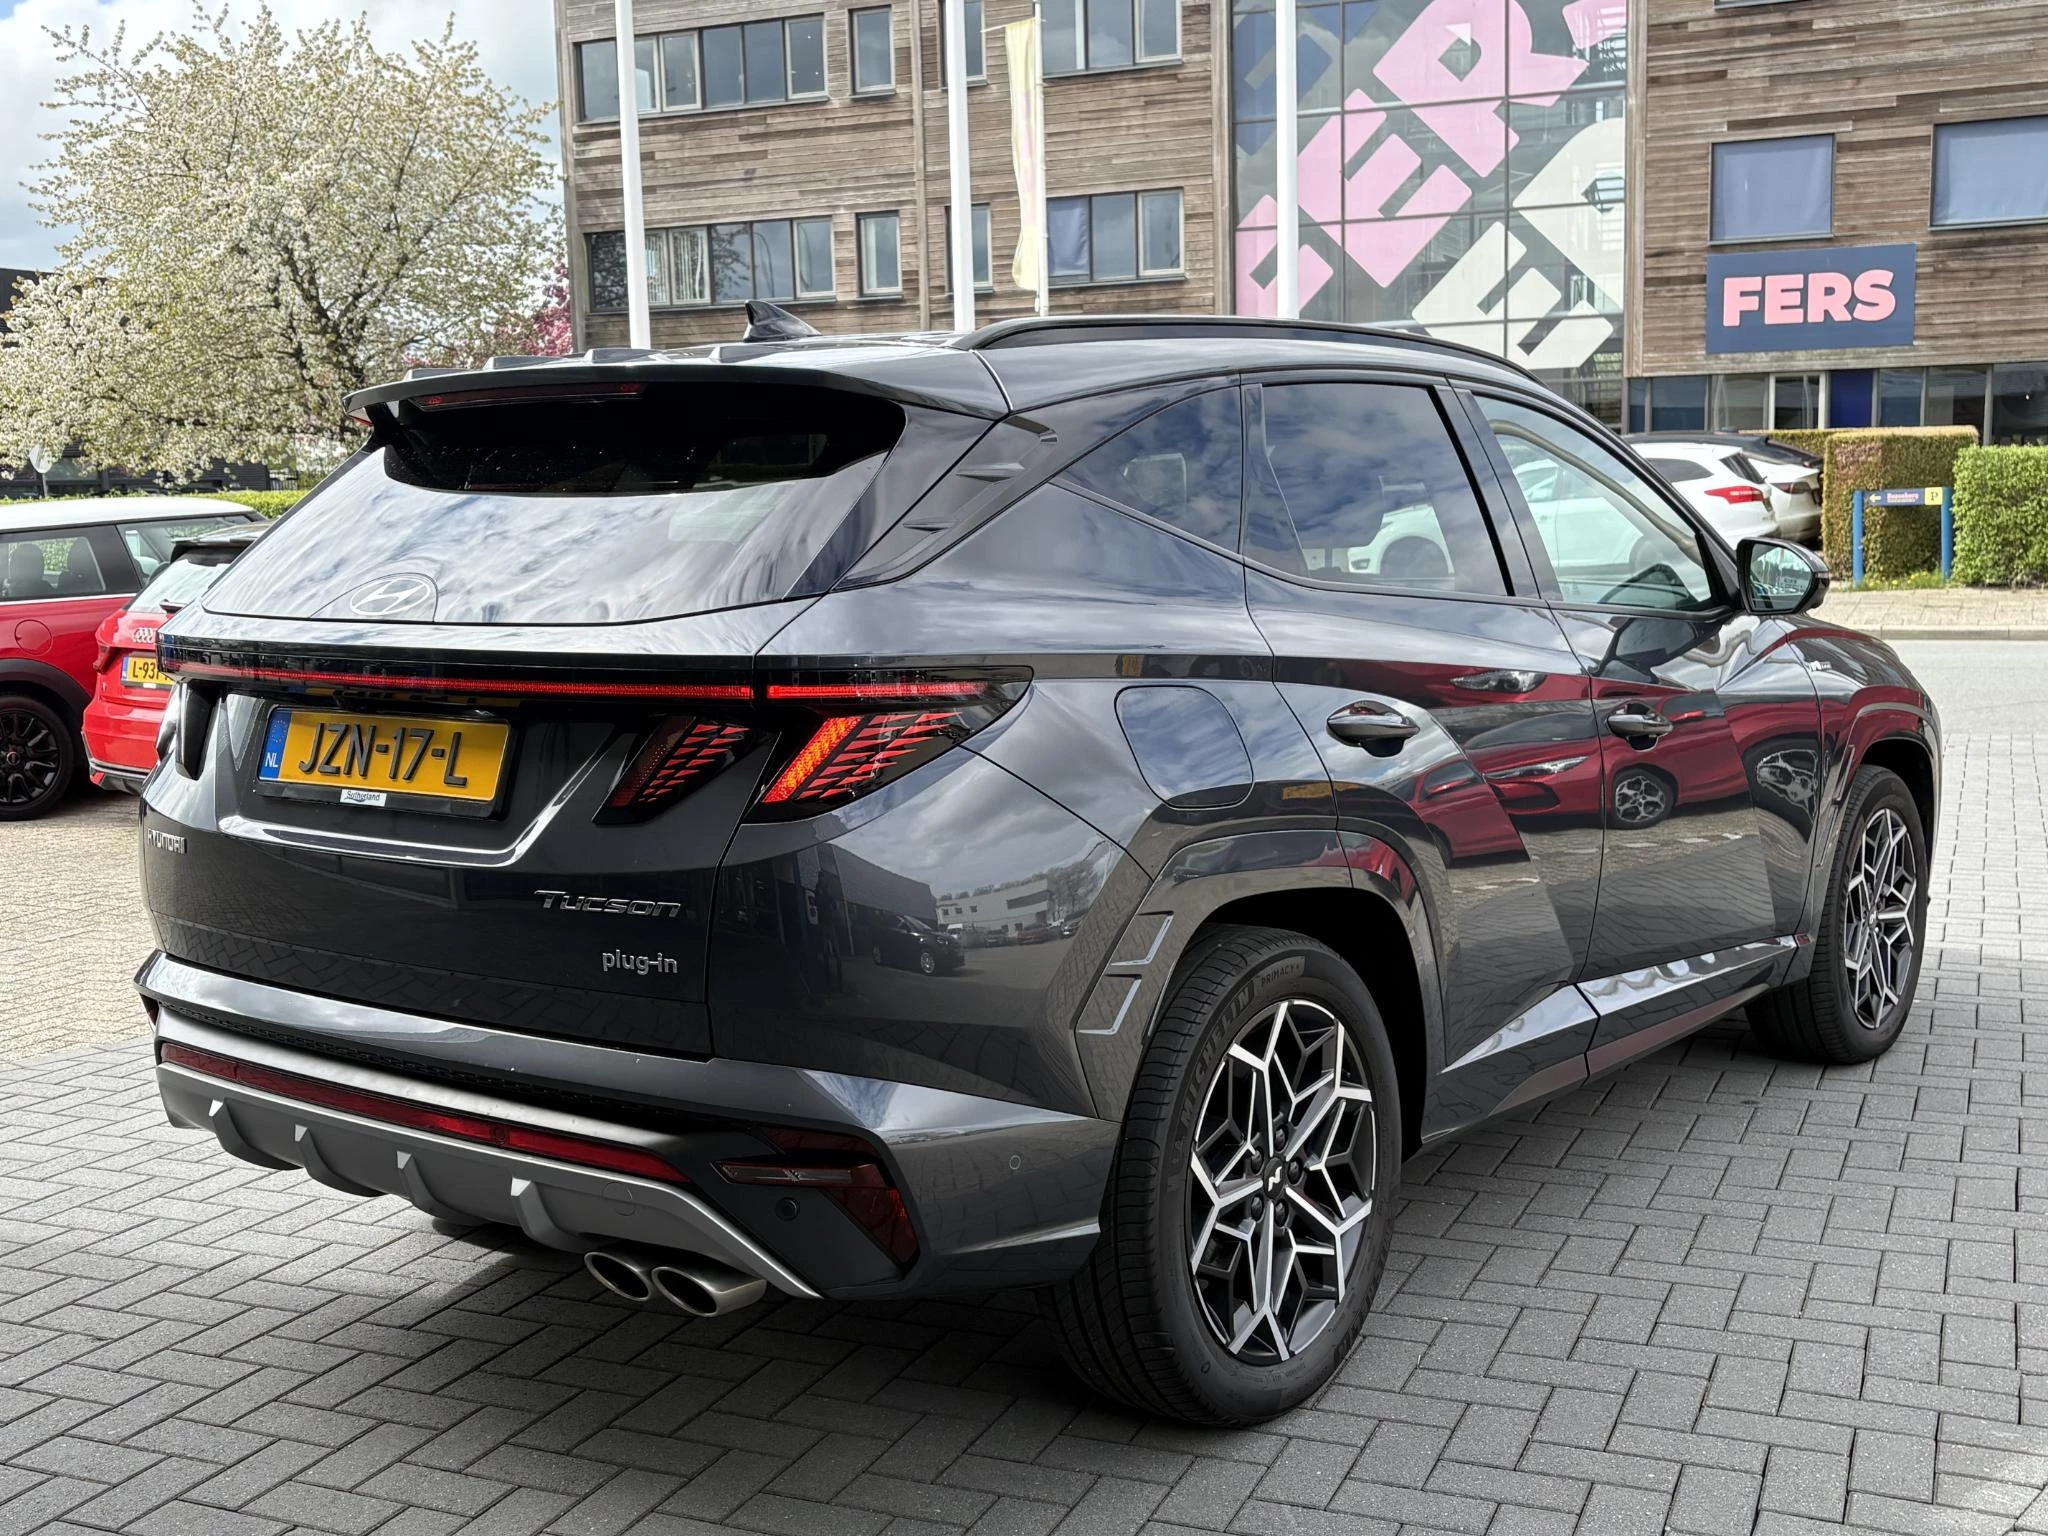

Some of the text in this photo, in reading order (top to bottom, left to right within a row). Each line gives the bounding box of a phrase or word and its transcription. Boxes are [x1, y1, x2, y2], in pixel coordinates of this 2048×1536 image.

[1723, 269, 1896, 327] FERS
[264, 752, 279, 769] NL
[299, 722, 468, 788] JZN-17-L
[602, 949, 678, 975] plug-in
